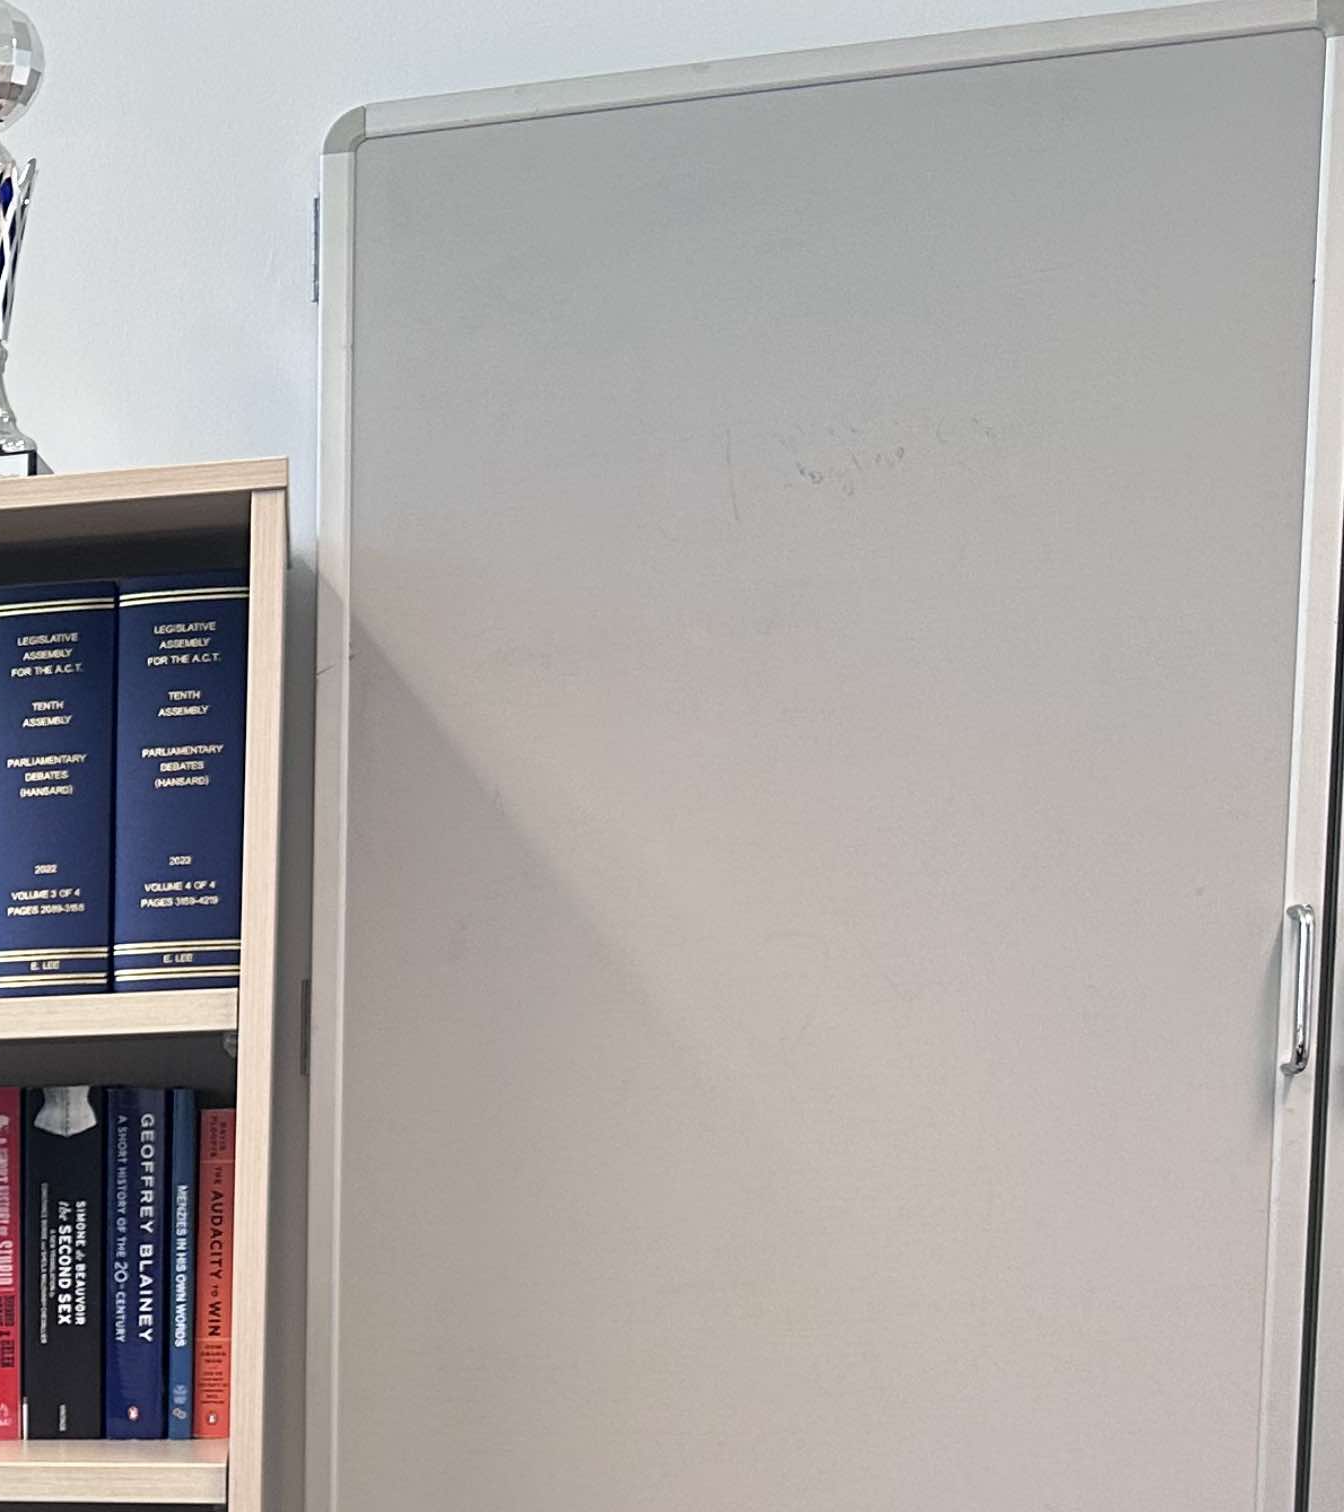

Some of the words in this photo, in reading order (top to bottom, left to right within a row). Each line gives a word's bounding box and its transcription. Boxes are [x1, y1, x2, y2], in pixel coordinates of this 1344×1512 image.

[153, 621, 217, 635] LEGISLATIVE
[17, 632, 79, 647] LEGISLATIVE
[158, 637, 211, 650] ASSEMBLY
[22, 648, 73, 661] ASSEMBLY
[147, 655, 168, 667] FOR
[170, 653, 189, 664] THE
[11, 666, 32, 678] FOR
[35, 665, 52, 676] THE
[168, 690, 200, 701] TENTH
[32, 701, 64, 711] TENTH
[158, 705, 209, 717] ASSEMBLY
[22, 715, 72, 728] ASSEMBLY
[141, 744, 224, 758] PARLIAMENTARY
[7, 754, 87, 769] PARLIAMENTARY
[159, 760, 204, 772] DEBATES
[24, 770, 69, 782] DEBATES
[154, 776, 209, 788] (HANSARD)
[20, 784, 73, 798] (HANSARD)
[144, 881, 182, 892] VOLUME
[194, 880, 207, 890] OF
[208, 880, 216, 890] 4
[11, 890, 49, 901] VOLUME
[59, 889, 73, 899] OF
[74, 888, 81, 898] 4
[140, 897, 173, 908] PAGES
[7, 905, 39, 917] PAGES
[42, 960, 61, 970] LEE
[175, 953, 194, 963] LEE
[117, 1115, 128, 1123] A
[116, 1126, 128, 1163] SHORT
[139, 1113, 154, 1233] GEOFFREY
[213, 1166, 222, 1184] THE
[116, 1167, 128, 1214] HISTORY
[58, 1201, 71, 1221] the
[175, 1185, 189, 1236] MENZIES
[75, 1201, 86, 1247] SIMONE
[116, 1217, 127, 1233] OF
[209, 1190, 224, 1279] AUDACITY
[116, 1237, 127, 1258] THE
[175, 1238, 188, 1250] IN
[58, 1225, 71, 1289] SECOND
[175, 1252, 188, 1272] HIS
[75, 1263, 86, 1325] BEAUVOIR
[138, 1244, 153, 1342] BLAINEY
[174, 1274, 188, 1302] OWN
[58, 1294, 72, 1325] SEX
[114, 1291, 126, 1342] CENTURY
[174, 1304, 188, 1348] WORDS
[208, 1301, 222, 1337] WIN
